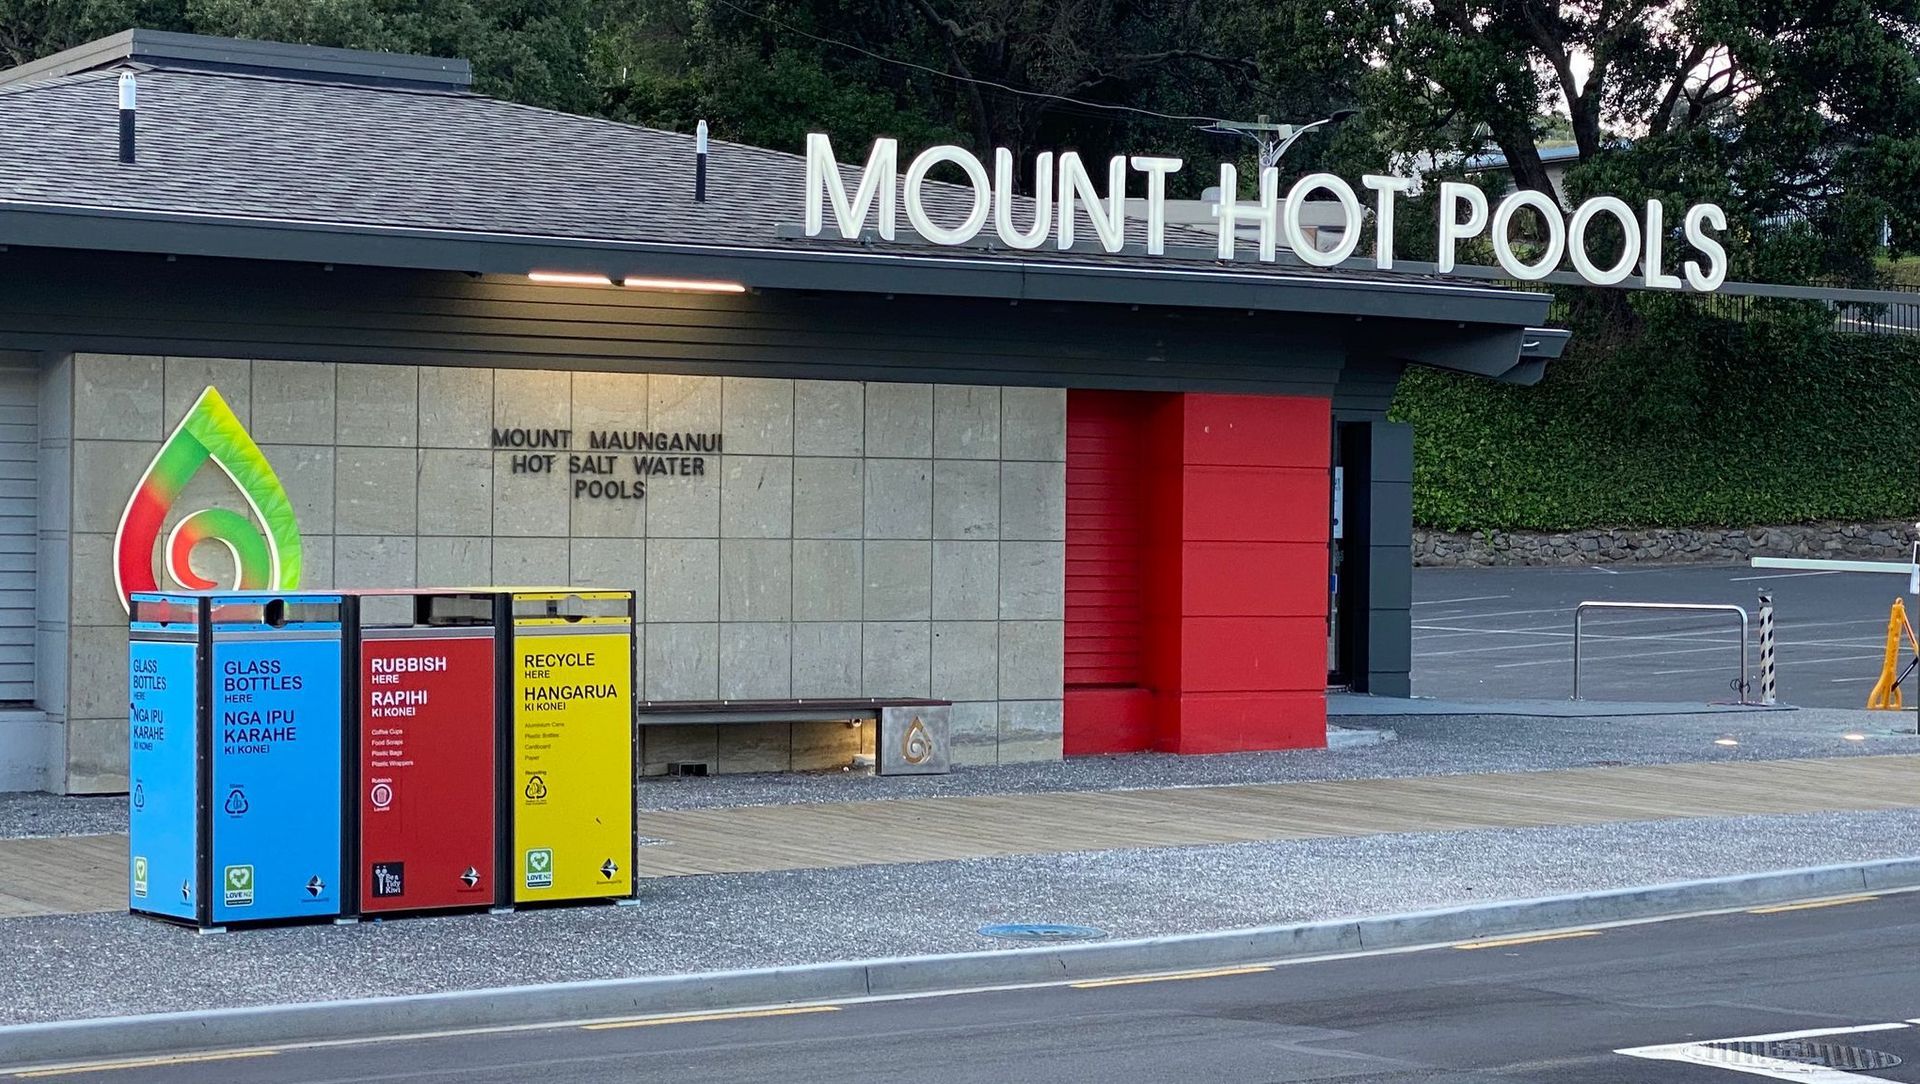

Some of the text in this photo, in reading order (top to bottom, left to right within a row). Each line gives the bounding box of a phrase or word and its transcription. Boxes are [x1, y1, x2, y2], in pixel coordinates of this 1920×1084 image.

[805, 133, 1728, 292] MOUNT HOT POOLS
[492, 428, 723, 451] MOUNT MAUNGANUI
[512, 454, 705, 476] HOT SALT WATER
[575, 480, 645, 499] POOLS
[133, 659, 157, 673] GLASS
[224, 660, 281, 675] GLASS
[371, 656, 447, 673] RUBBISH
[525, 653, 595, 668] RECYCLE
[371, 674, 400, 684] HERE
[525, 670, 550, 679] HERE
[133, 675, 167, 690] BOTTLES
[224, 675, 303, 691] BOTTLES
[224, 693, 253, 703] HERE
[371, 690, 428, 706] RAPIHI
[525, 684, 617, 701] HANGARUA
[371, 706, 416, 717] KI KONEI
[525, 702, 566, 711] KI KONEI
[133, 708, 163, 723] NGA IPU
[224, 709, 295, 726] NGA IPU
[133, 725, 164, 740] KARAHE
[224, 727, 297, 743] KARAHE
[224, 744, 270, 755] KI KONEI
[385, 880, 401, 888] Tidy
[527, 873, 542, 881] LOVE
[226, 890, 242, 899] LOVE
[385, 886, 401, 894] Kiwi
